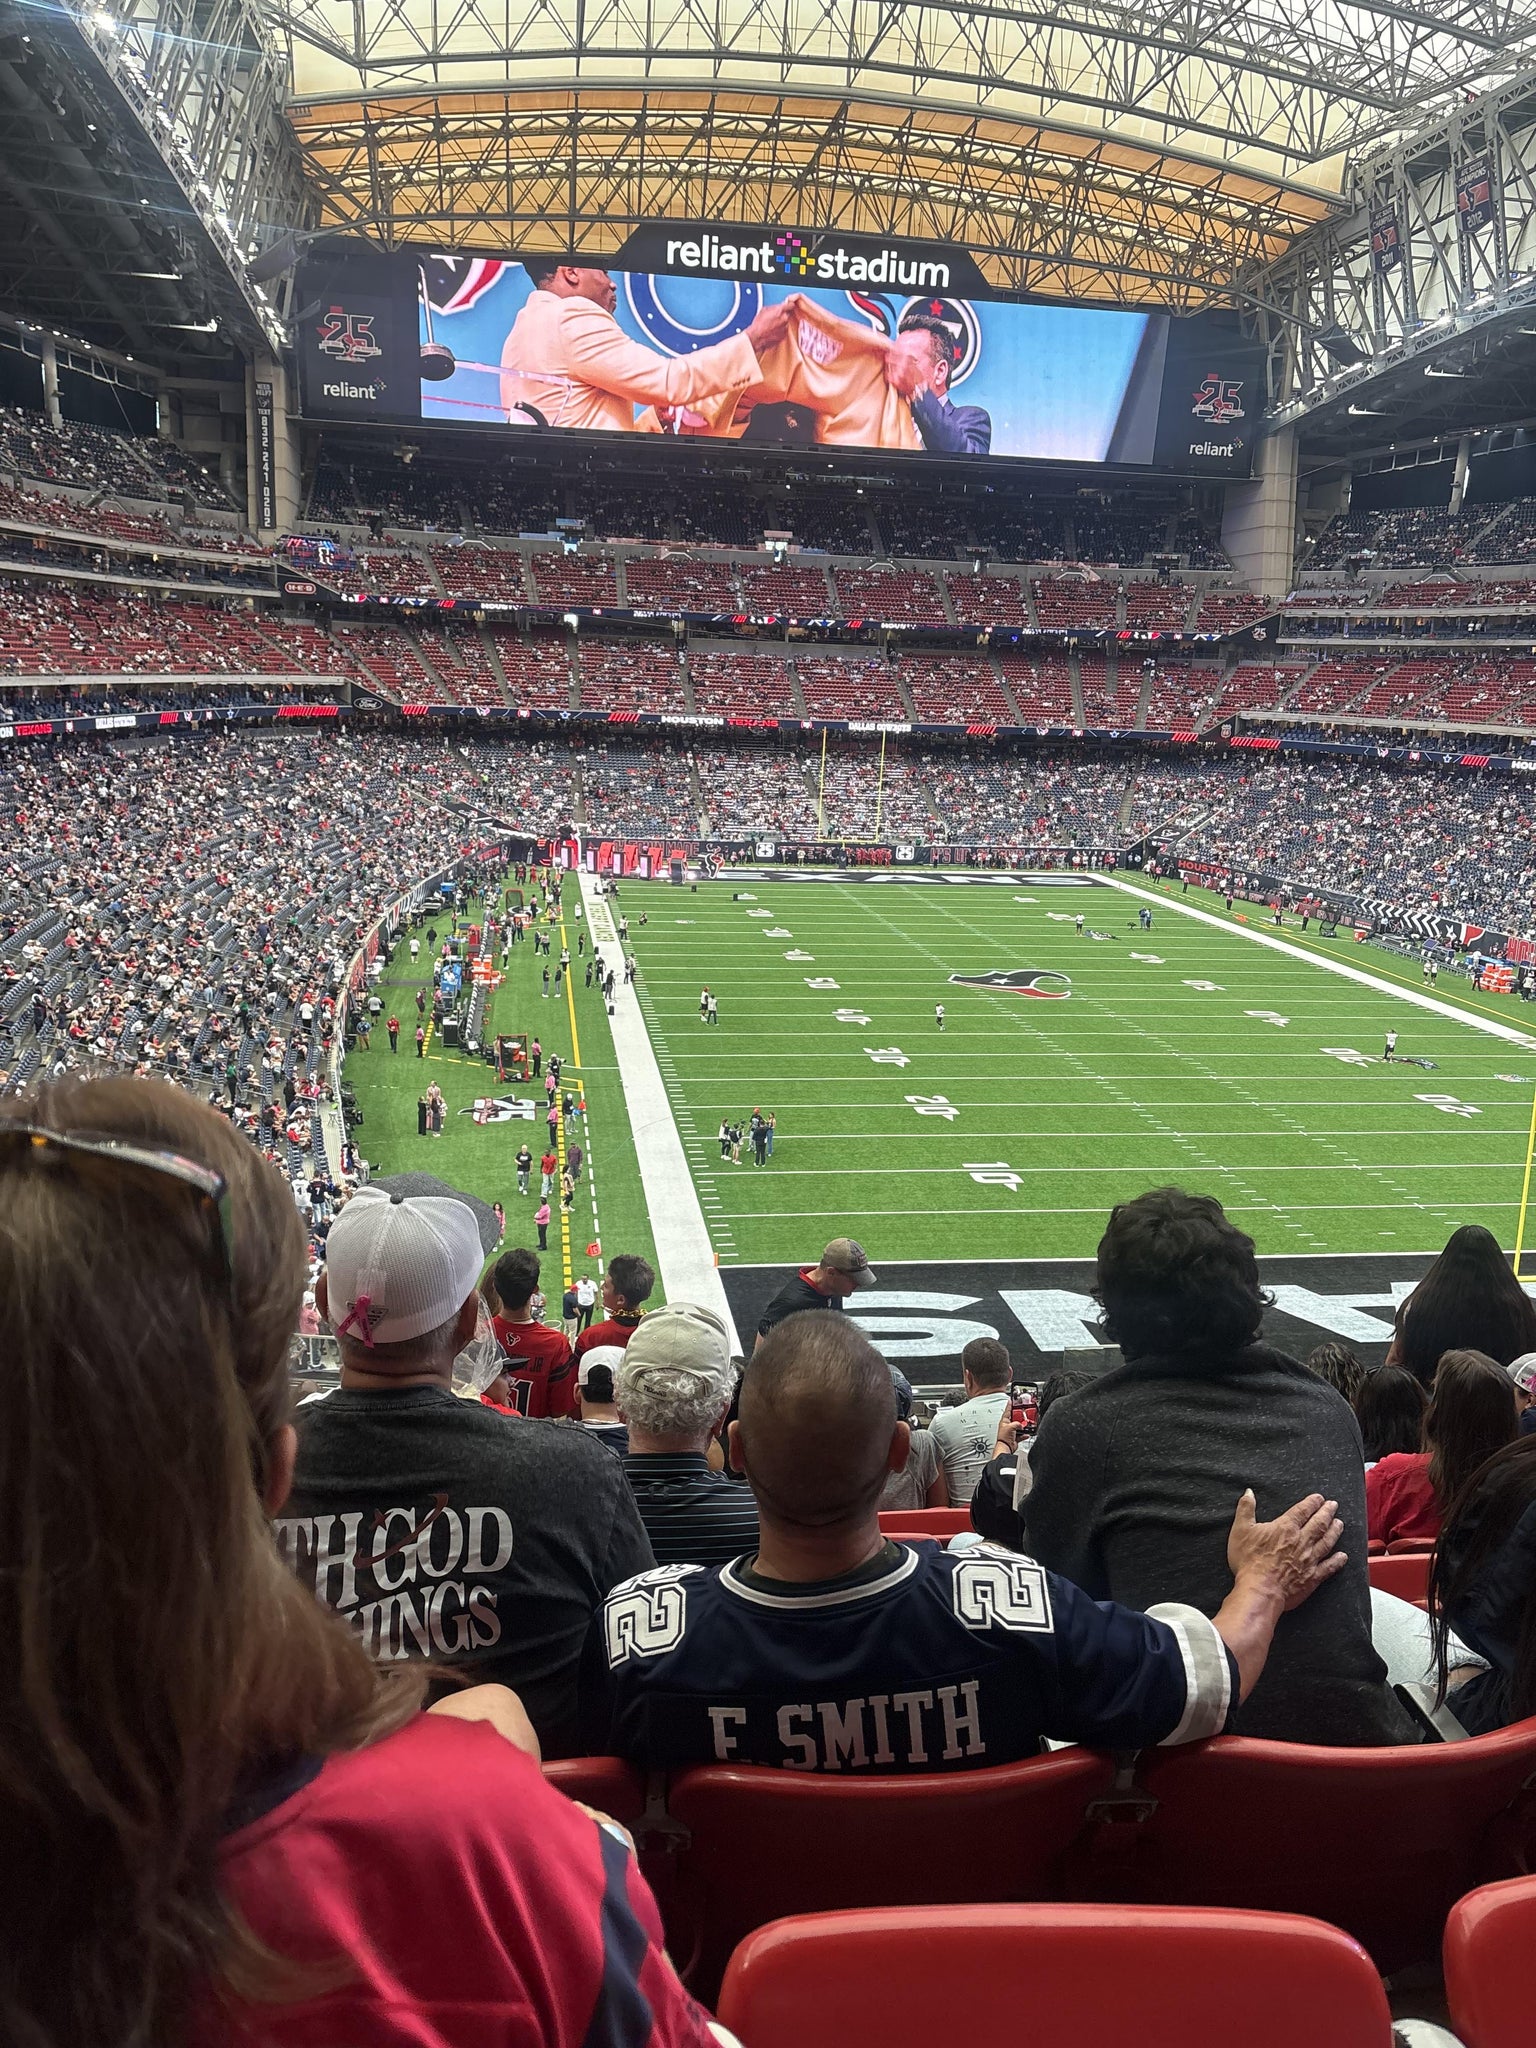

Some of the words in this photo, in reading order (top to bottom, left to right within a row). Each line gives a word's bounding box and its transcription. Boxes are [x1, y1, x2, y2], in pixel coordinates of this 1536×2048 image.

[1466, 211, 1484, 229] 2012
[666, 234, 776, 273] reliant
[816, 248, 950, 288] stadium
[323, 312, 376, 357] 25
[323, 381, 377, 400] reliant
[1197, 379, 1244, 419] 25
[257, 408, 271, 416] TEXT
[1189, 441, 1234, 457] reliant
[15, 723, 53, 737] TEXANS
[660, 715, 724, 726] HOUSTON
[727, 718, 779, 728] TEXANS
[848, 722, 876, 732] DALLAS
[716, 871, 1093, 886] EXANS
[862, 1046, 912, 1063] 30
[904, 1095, 960, 1116] 20
[1412, 1094, 1484, 1113] 20
[962, 1161, 1025, 1184] 10
[272, 1511, 364, 1609] TH
[371, 1505, 514, 1592] GOD
[338, 1580, 502, 1662] HINGS
[776, 1680, 986, 1772] SMITH
